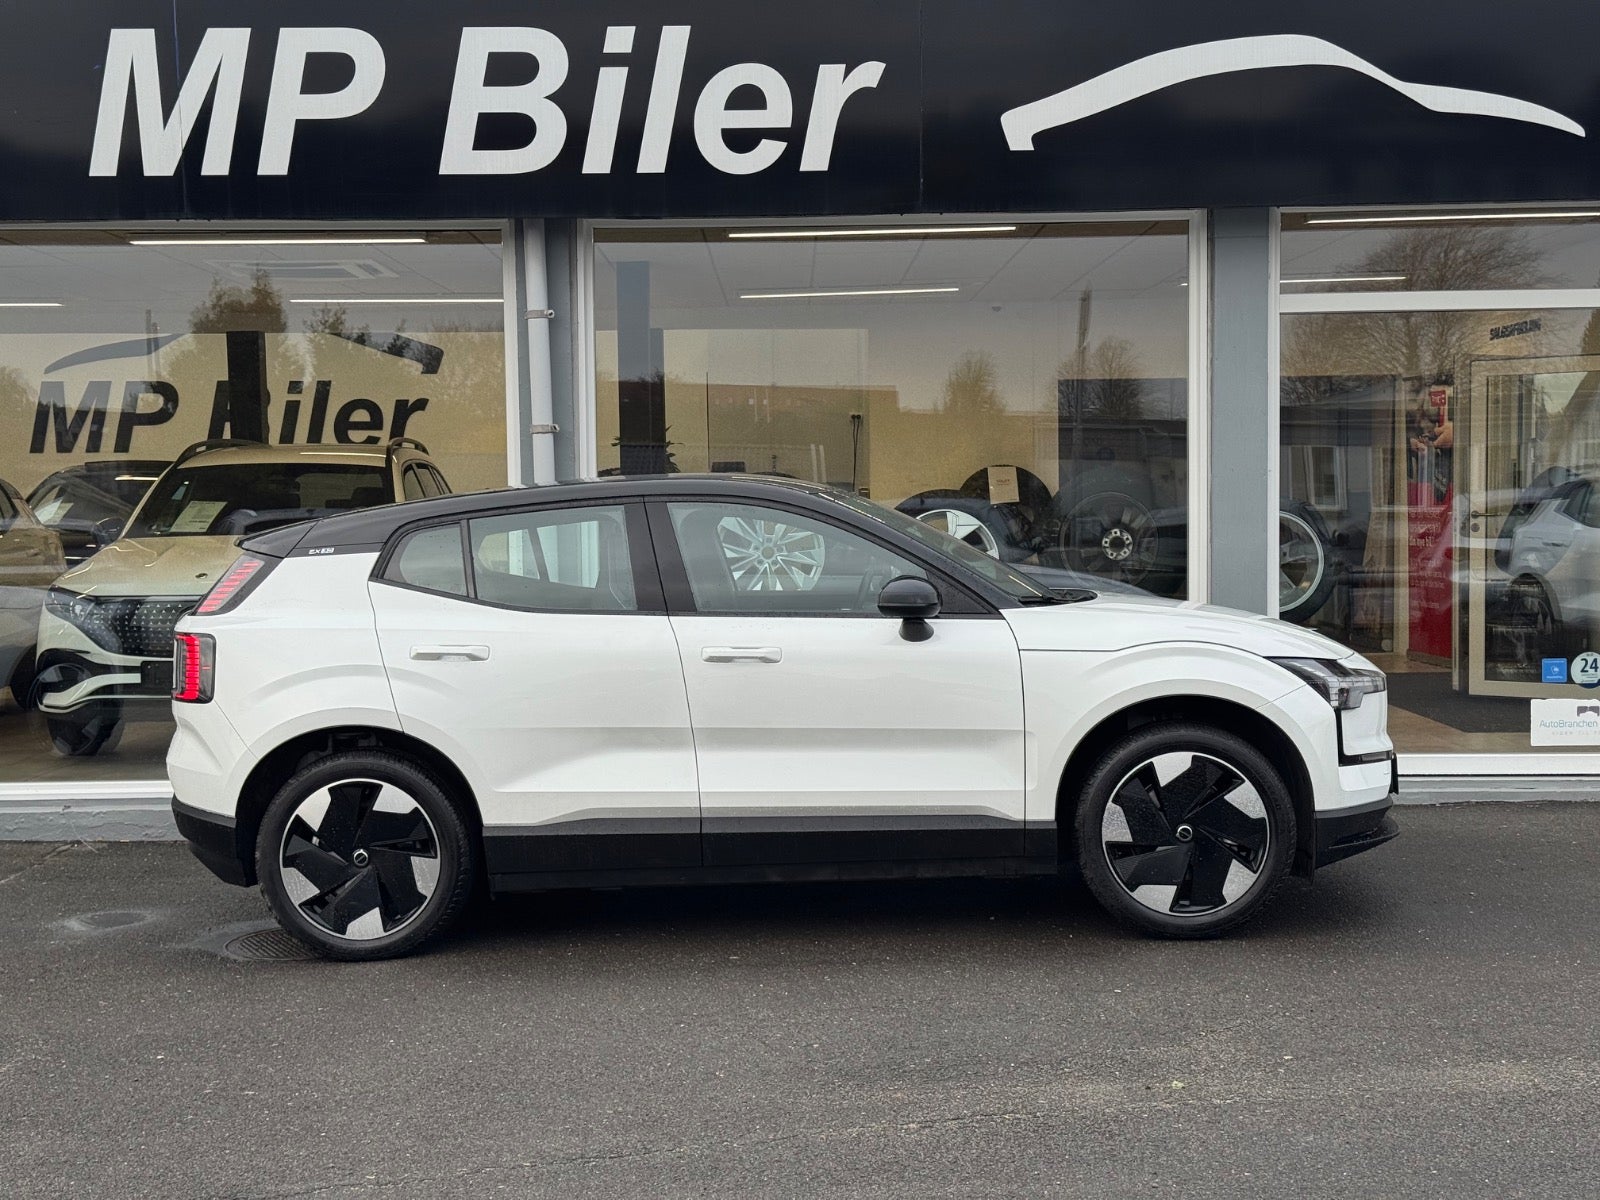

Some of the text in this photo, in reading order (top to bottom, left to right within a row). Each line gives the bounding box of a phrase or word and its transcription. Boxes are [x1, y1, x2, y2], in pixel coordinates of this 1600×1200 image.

[88, 25, 887, 177] MP Biler
[29, 380, 180, 454] MP
[1580, 657, 1599, 673] 24
[1539, 719, 1598, 728] AutoBranchen
